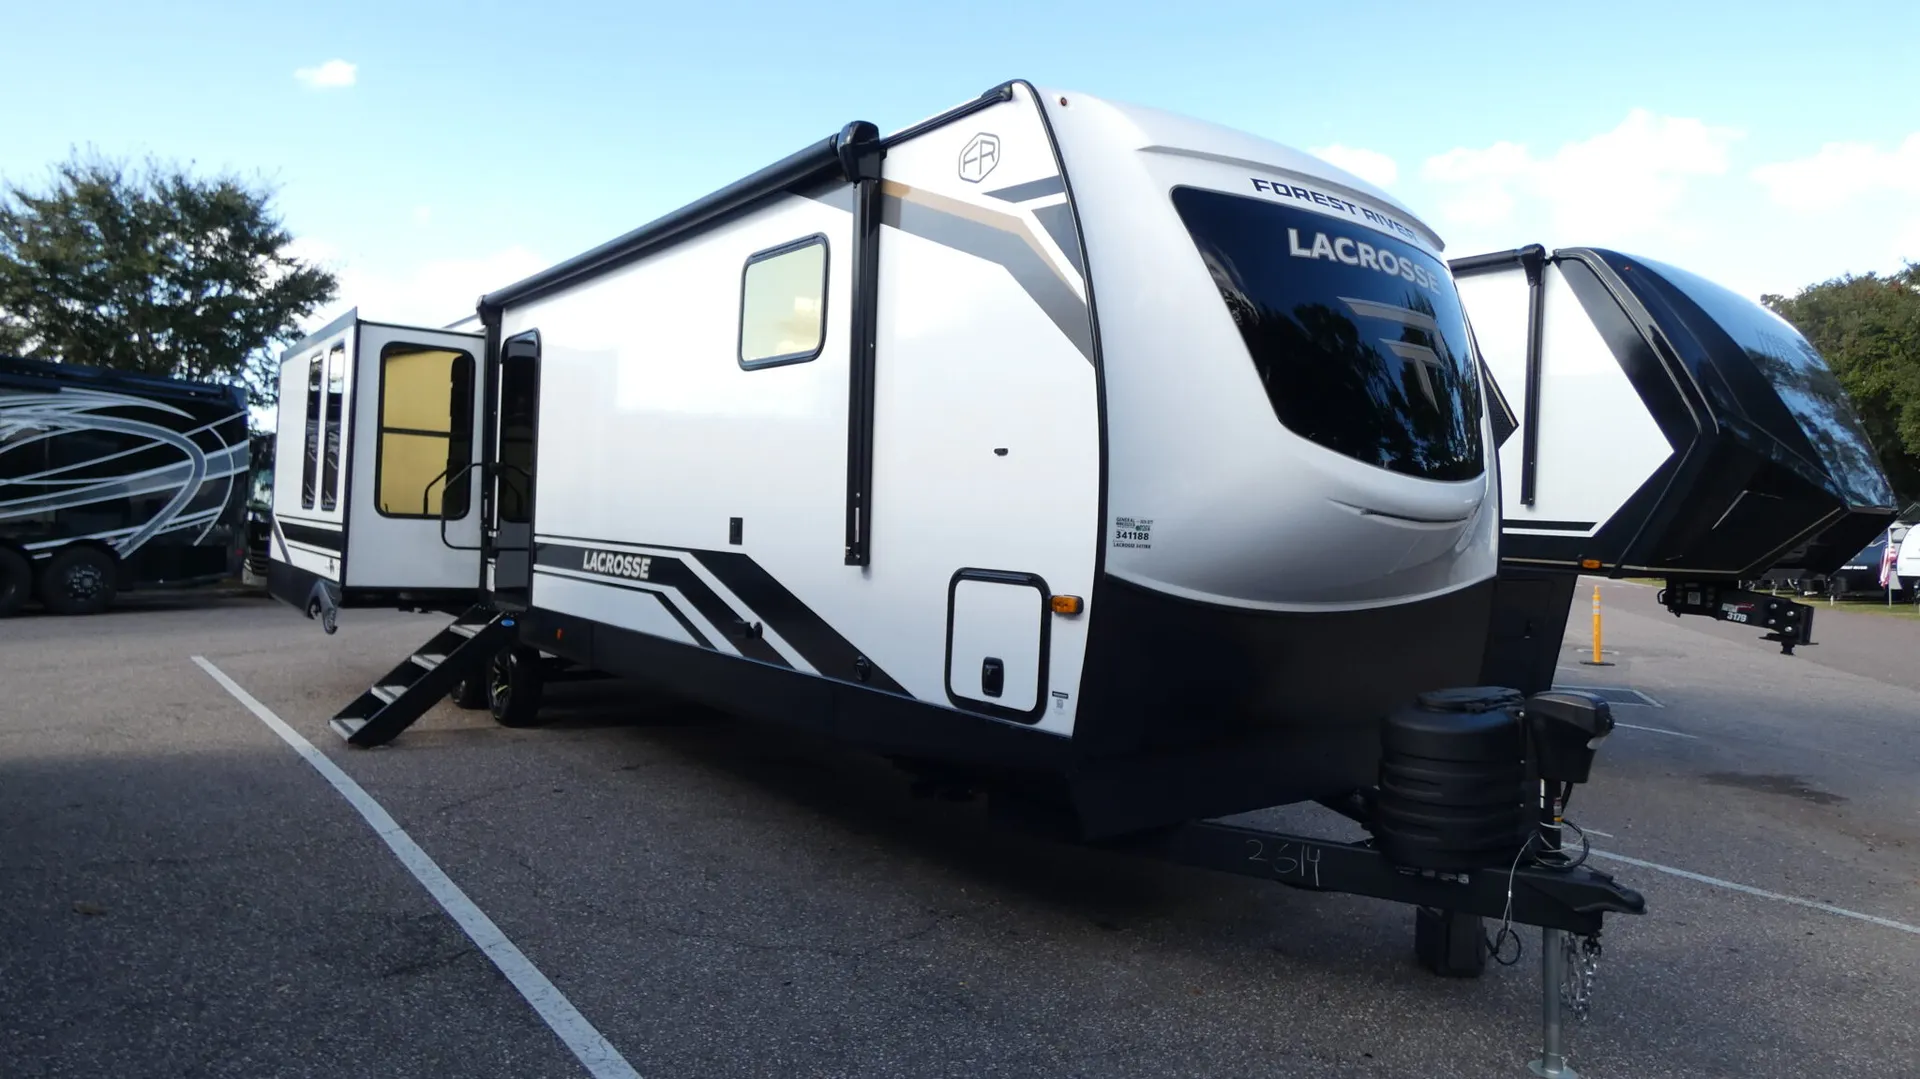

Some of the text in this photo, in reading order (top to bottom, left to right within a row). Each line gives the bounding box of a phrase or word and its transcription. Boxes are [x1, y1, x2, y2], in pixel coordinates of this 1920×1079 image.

[1250, 177, 1420, 244] FOREST RIVER
[1287, 227, 1441, 296] LACROSSE
[1115, 530, 1150, 541] 341188
[583, 550, 652, 580] LACROSSE
